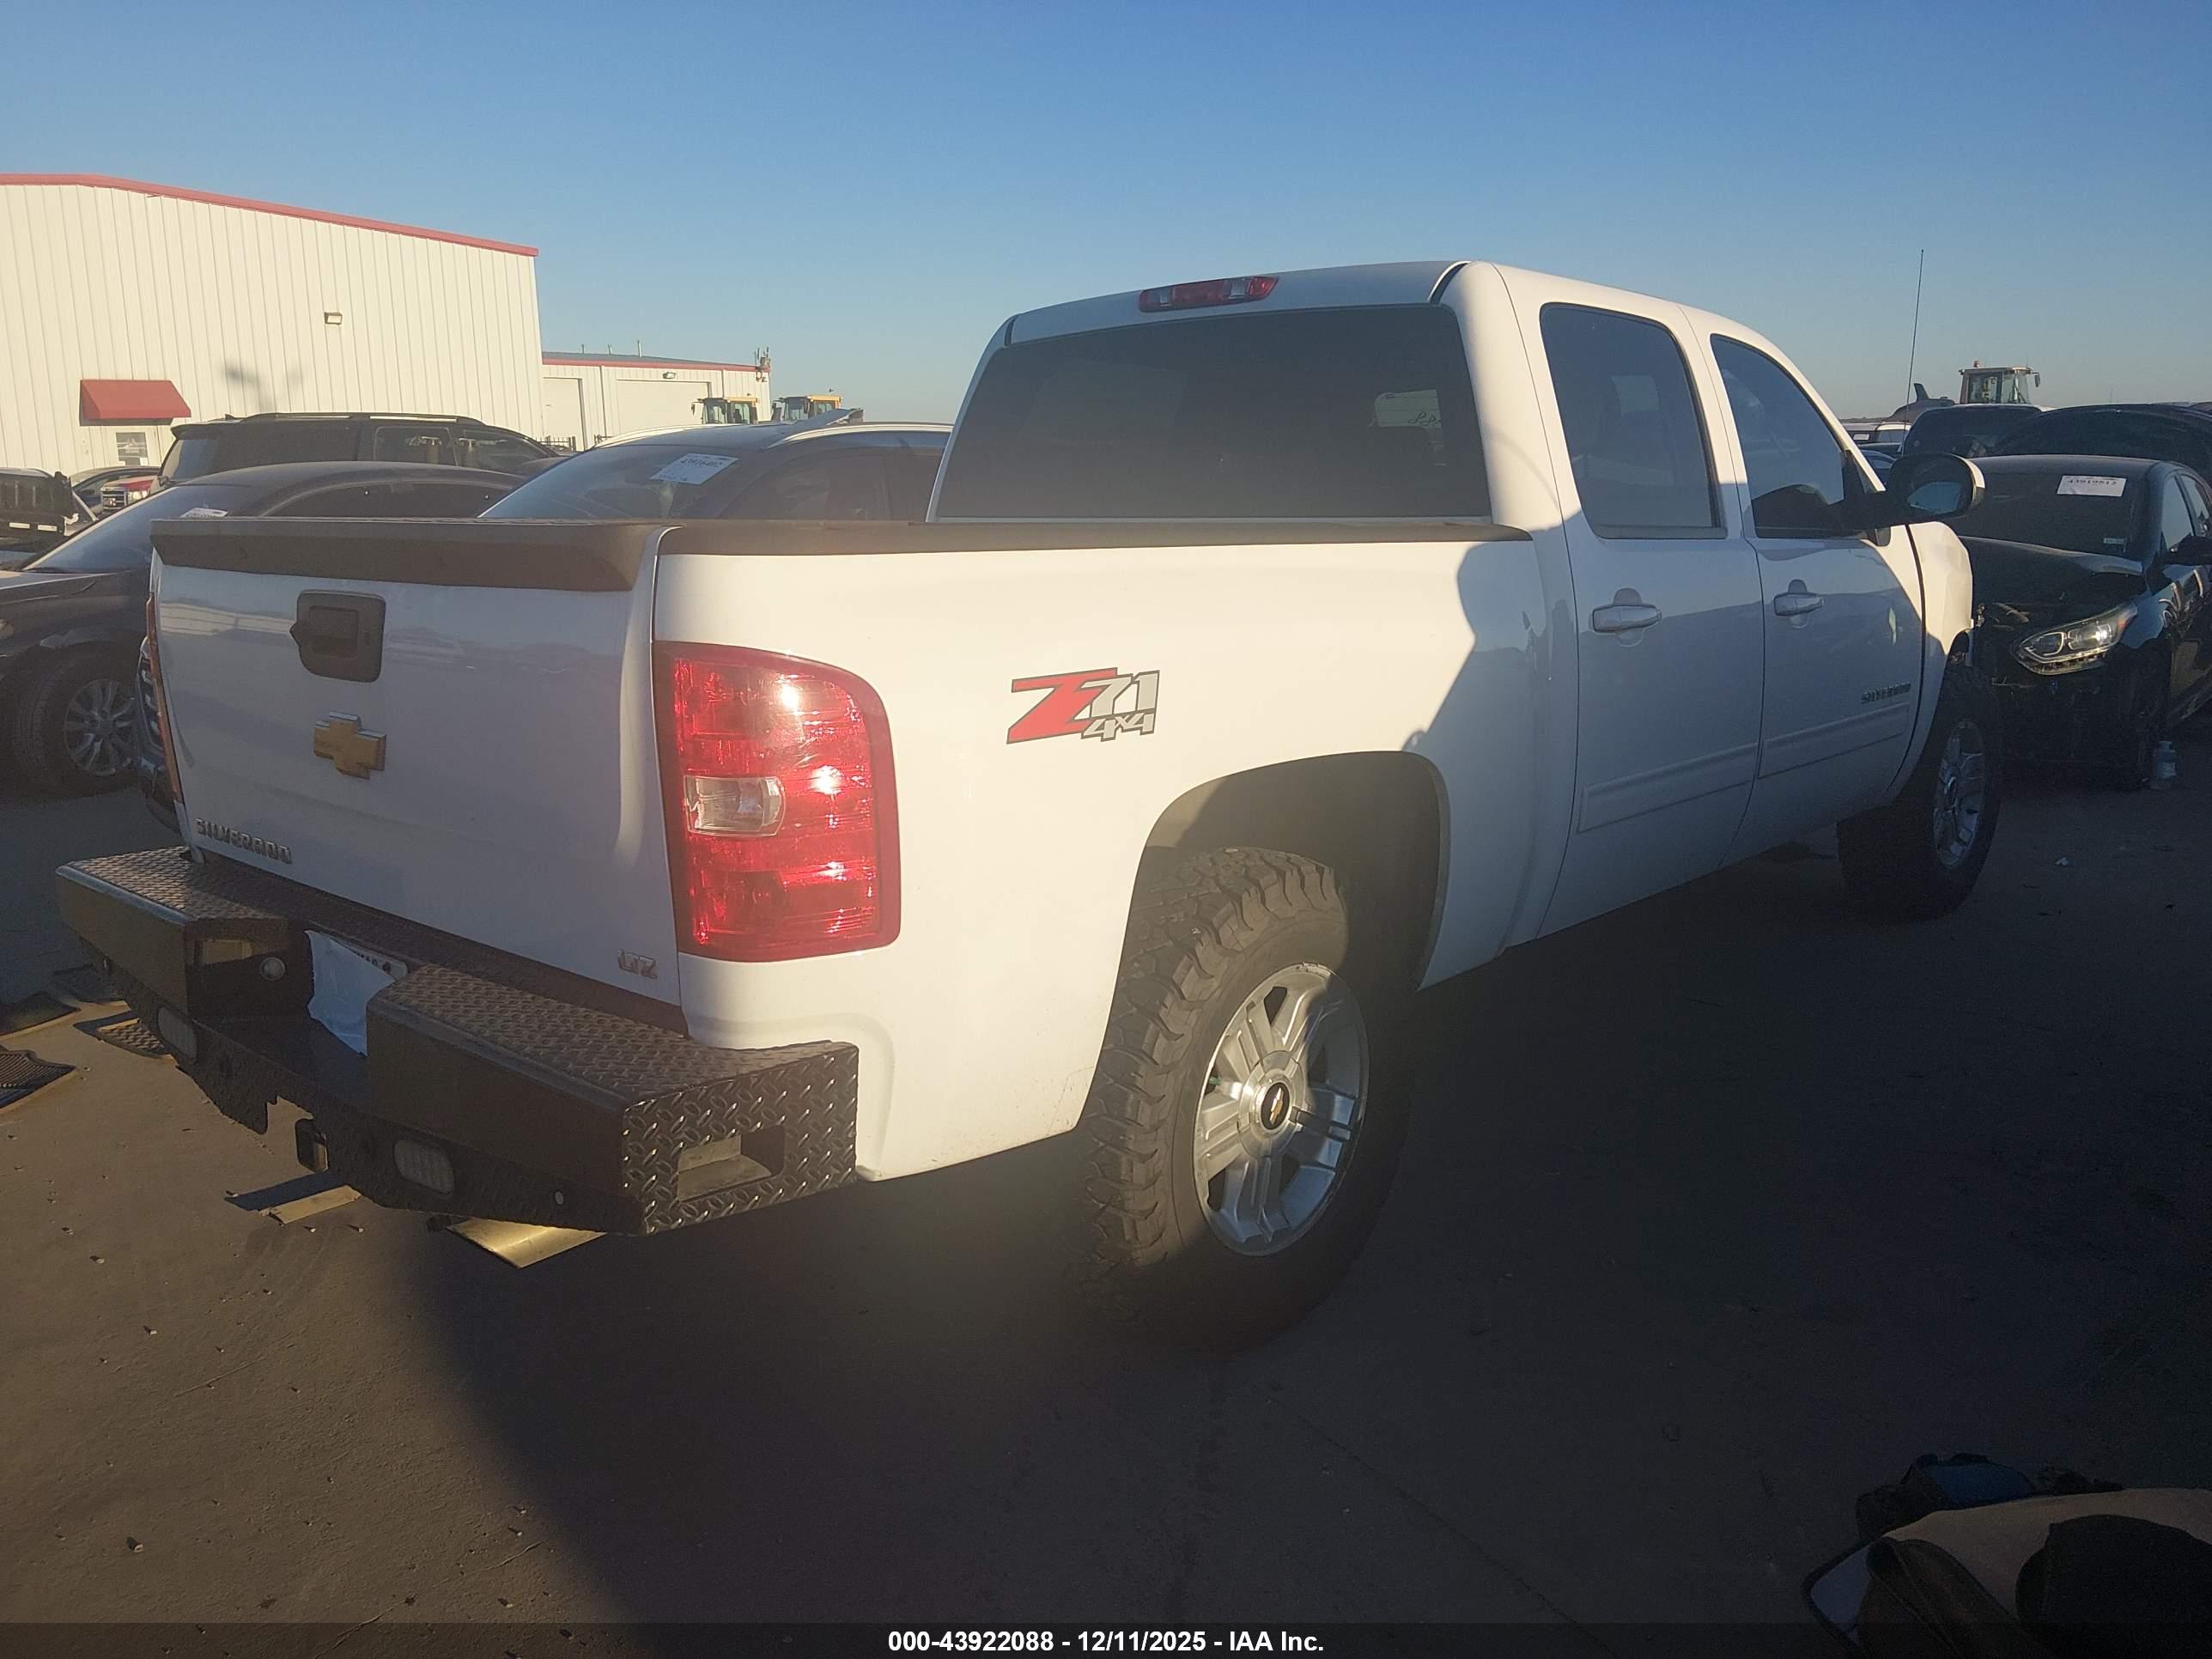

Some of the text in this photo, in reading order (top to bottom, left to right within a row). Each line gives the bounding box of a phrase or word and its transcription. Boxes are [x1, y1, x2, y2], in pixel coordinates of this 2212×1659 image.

[1006, 666, 1160, 744] Z71
[194, 817, 293, 865] SILVERADO
[617, 948, 658, 979] LTZ
